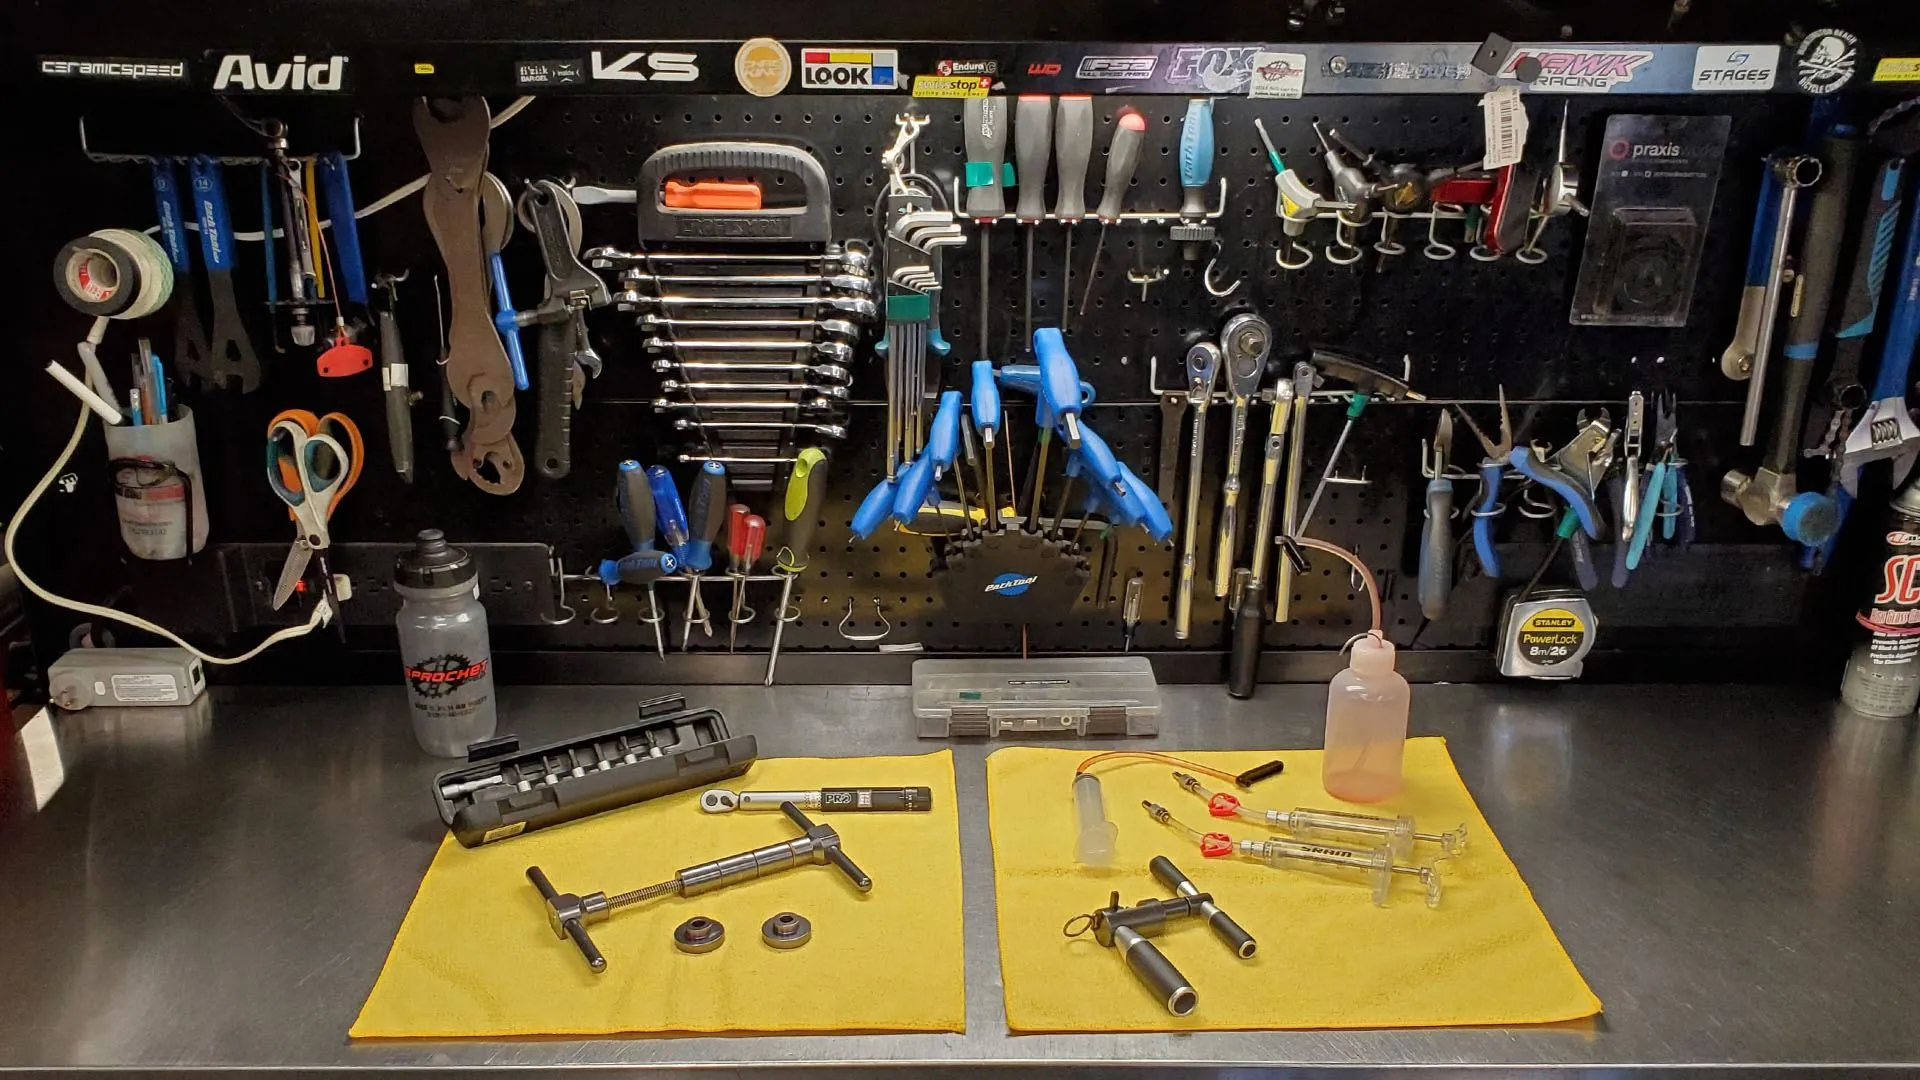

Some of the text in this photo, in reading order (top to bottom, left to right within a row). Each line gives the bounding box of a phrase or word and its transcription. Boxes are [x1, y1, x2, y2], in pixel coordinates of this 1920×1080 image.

[42, 61, 183, 79] ceramicspeed
[591, 51, 699, 81] KS
[1169, 47, 1263, 80] FOX
[213, 54, 343, 90] Avid
[805, 67, 869, 85] LOOK
[1699, 69, 1771, 81] STAGES
[1534, 77, 1607, 87] RACING
[1632, 143, 1680, 158] praxis
[1523, 633, 1577, 645] PowerLock
[1529, 646, 1568, 655] 8m/26
[825, 793, 851, 804] PRO
